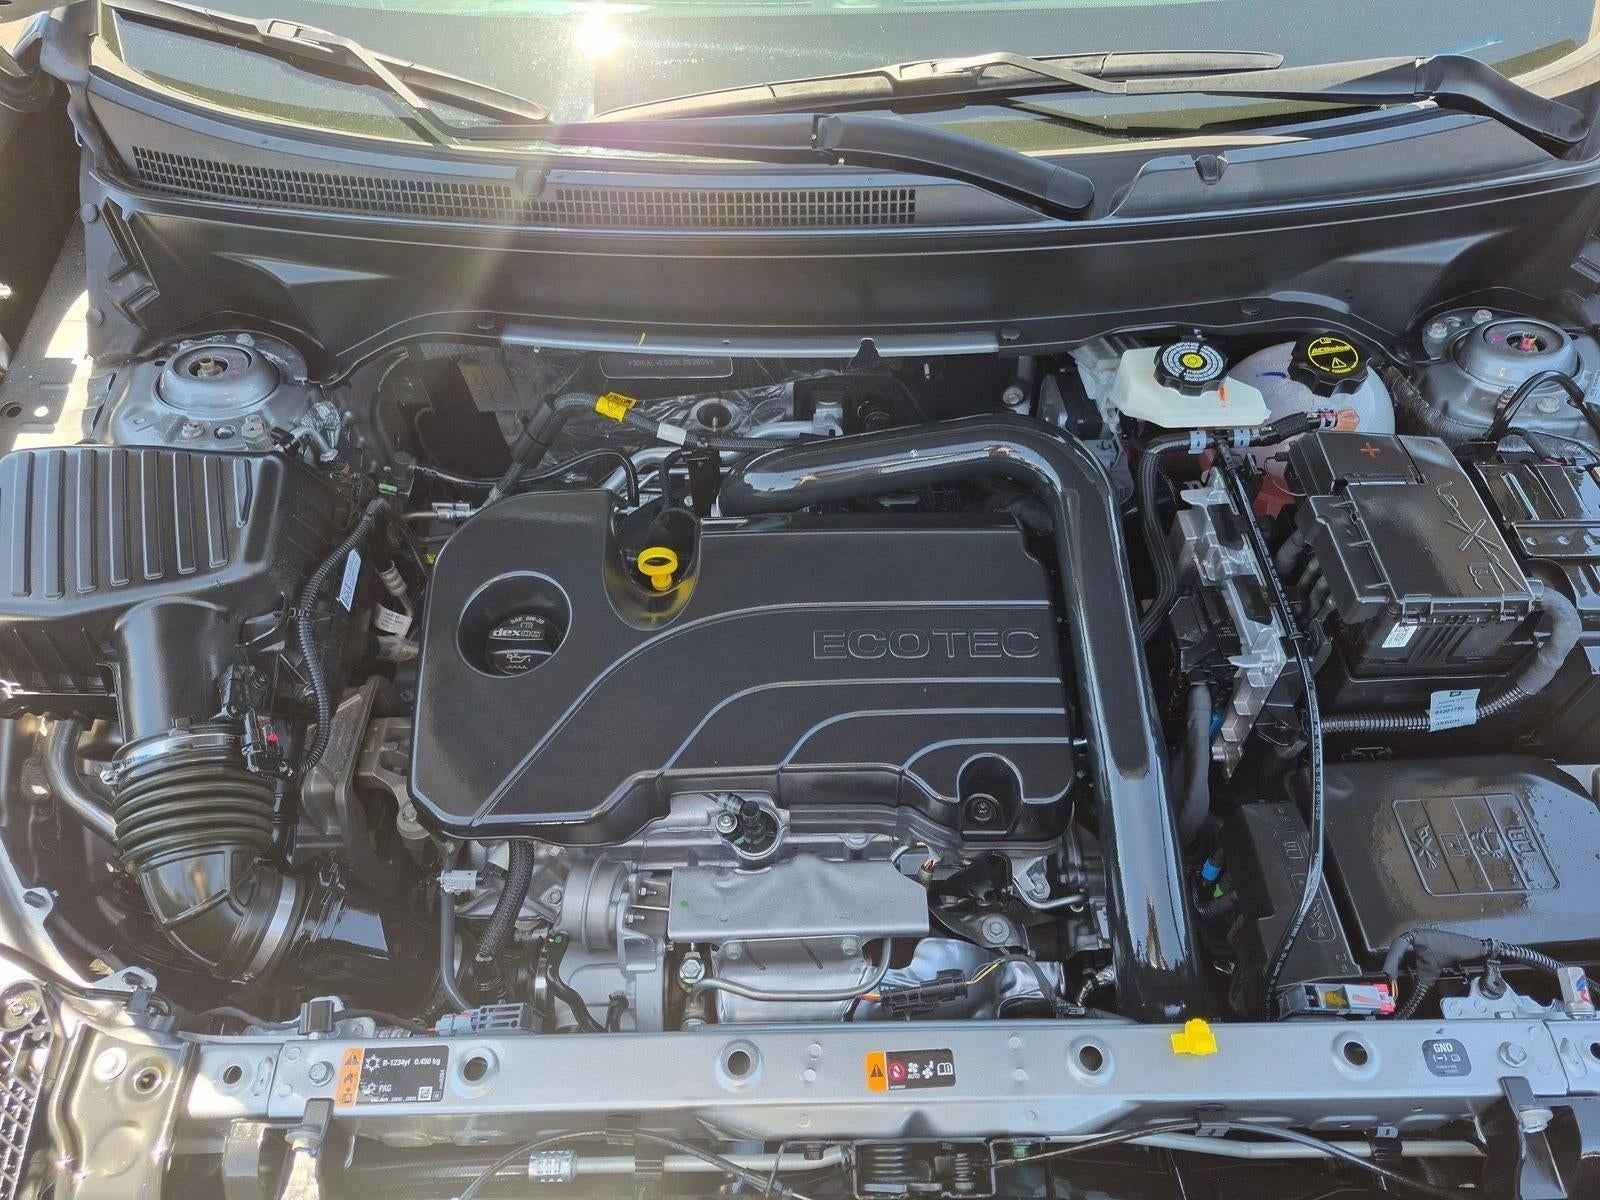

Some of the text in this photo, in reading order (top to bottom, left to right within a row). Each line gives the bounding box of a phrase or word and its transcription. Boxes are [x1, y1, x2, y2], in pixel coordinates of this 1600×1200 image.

[492, 628, 542, 638] dexos
[813, 628, 1040, 659] ECOTEC
[1433, 1042, 1454, 1053] GND
[382, 1057, 441, 1067] R-1234yf 0.450 kg
[379, 1084, 392, 1092] PAG
